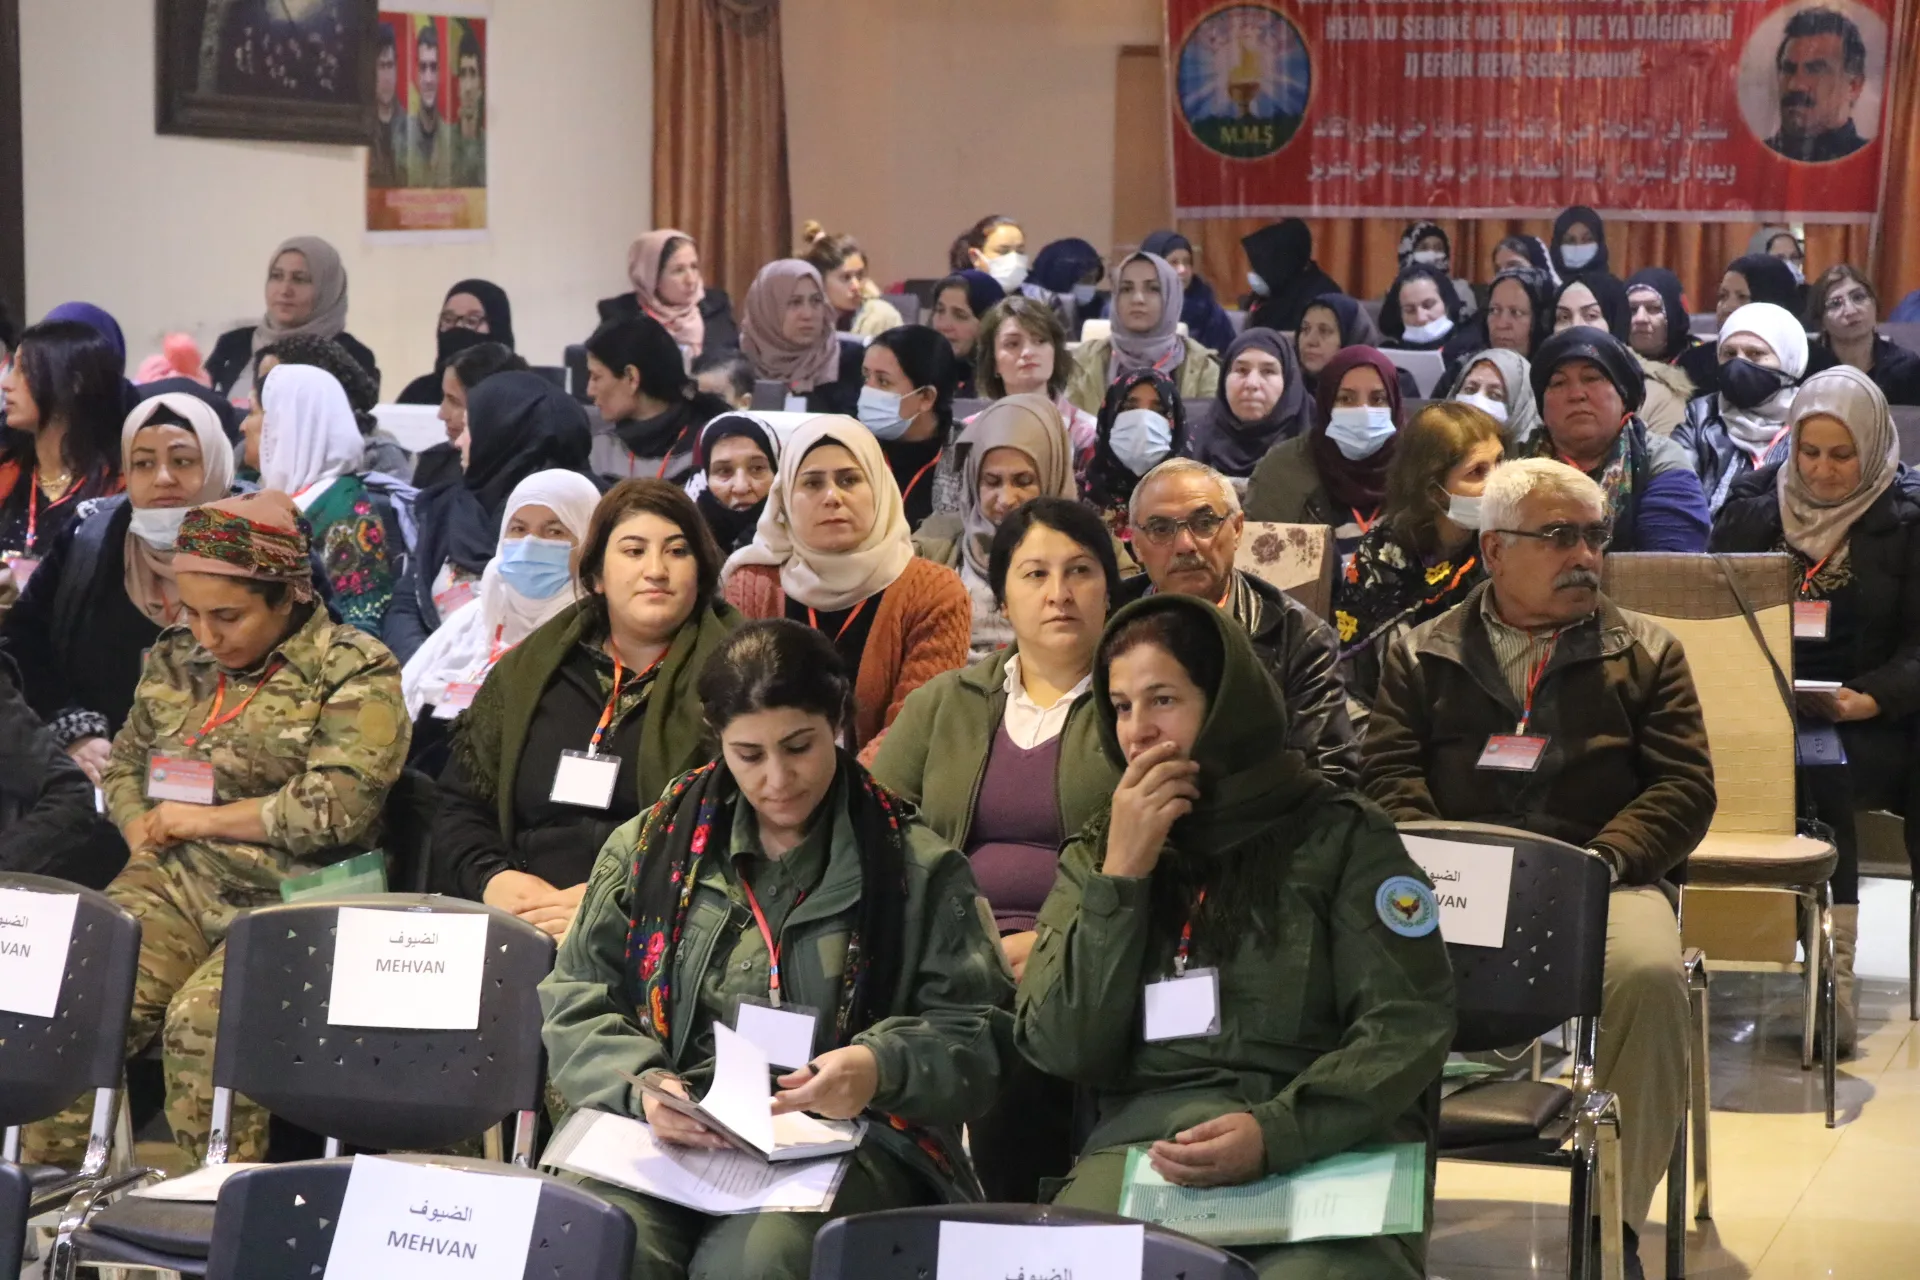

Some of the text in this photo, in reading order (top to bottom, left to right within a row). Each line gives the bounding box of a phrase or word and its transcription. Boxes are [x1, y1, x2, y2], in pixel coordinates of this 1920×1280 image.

[1325, 15, 1369, 41] HEYA
[1373, 15, 1398, 41] KU
[1474, 15, 1501, 41] ME
[1575, 14, 1603, 41] ME
[1608, 14, 1630, 41] YA
[1422, 866, 1461, 882] الضيو
[1435, 893, 1467, 909] VAN
[0, 914, 29, 929] الضي
[388, 930, 440, 948] الضيوف
[0, 940, 31, 958] VAN
[375, 958, 445, 974] MEHVAN
[408, 1199, 473, 1223] الضيوف
[386, 1229, 478, 1260] MEHVAN
